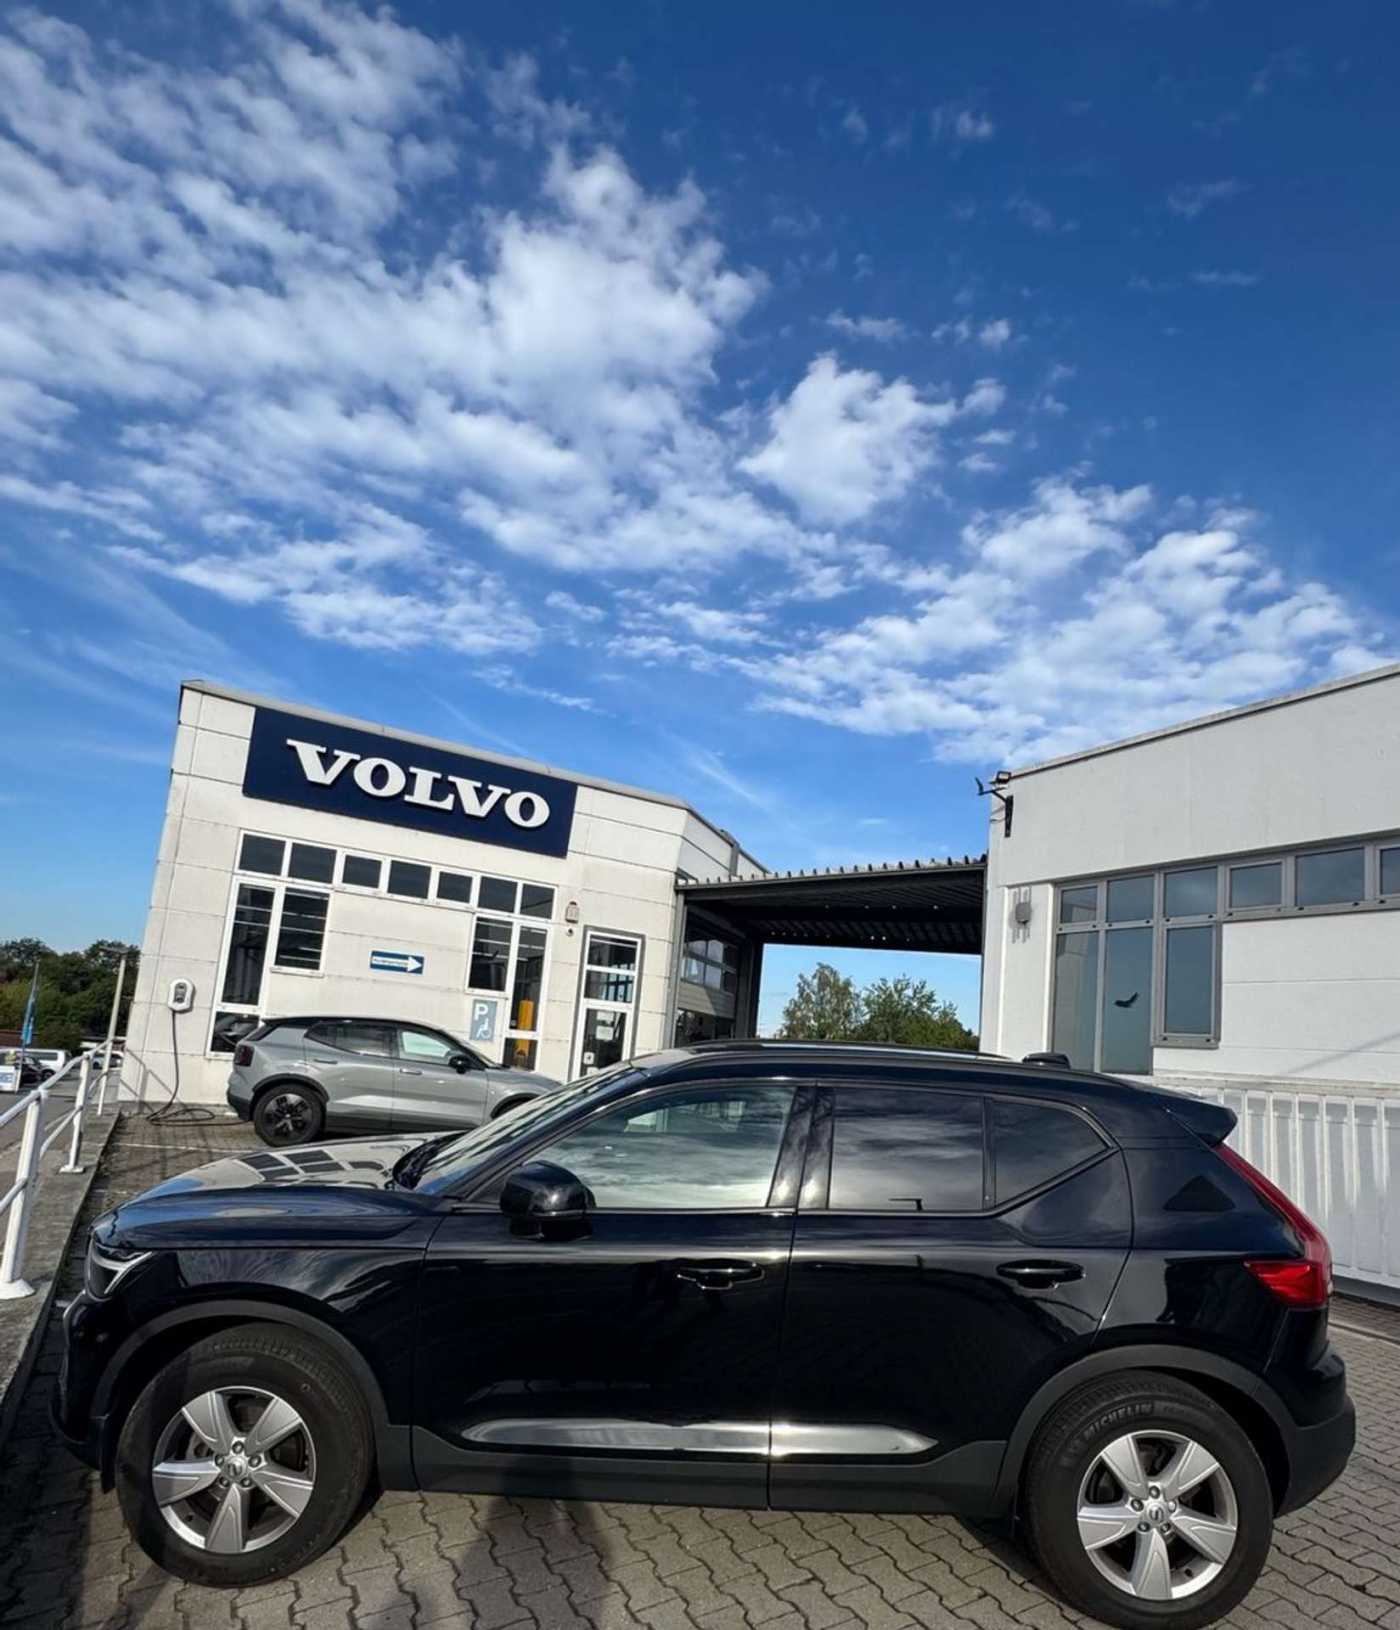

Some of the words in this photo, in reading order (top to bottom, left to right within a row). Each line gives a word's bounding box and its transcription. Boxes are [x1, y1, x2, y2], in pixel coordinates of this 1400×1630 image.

[286, 738, 550, 828] VOLVO
[474, 1003, 489, 1021] P
[1083, 1403, 1152, 1439] MICHELIN
